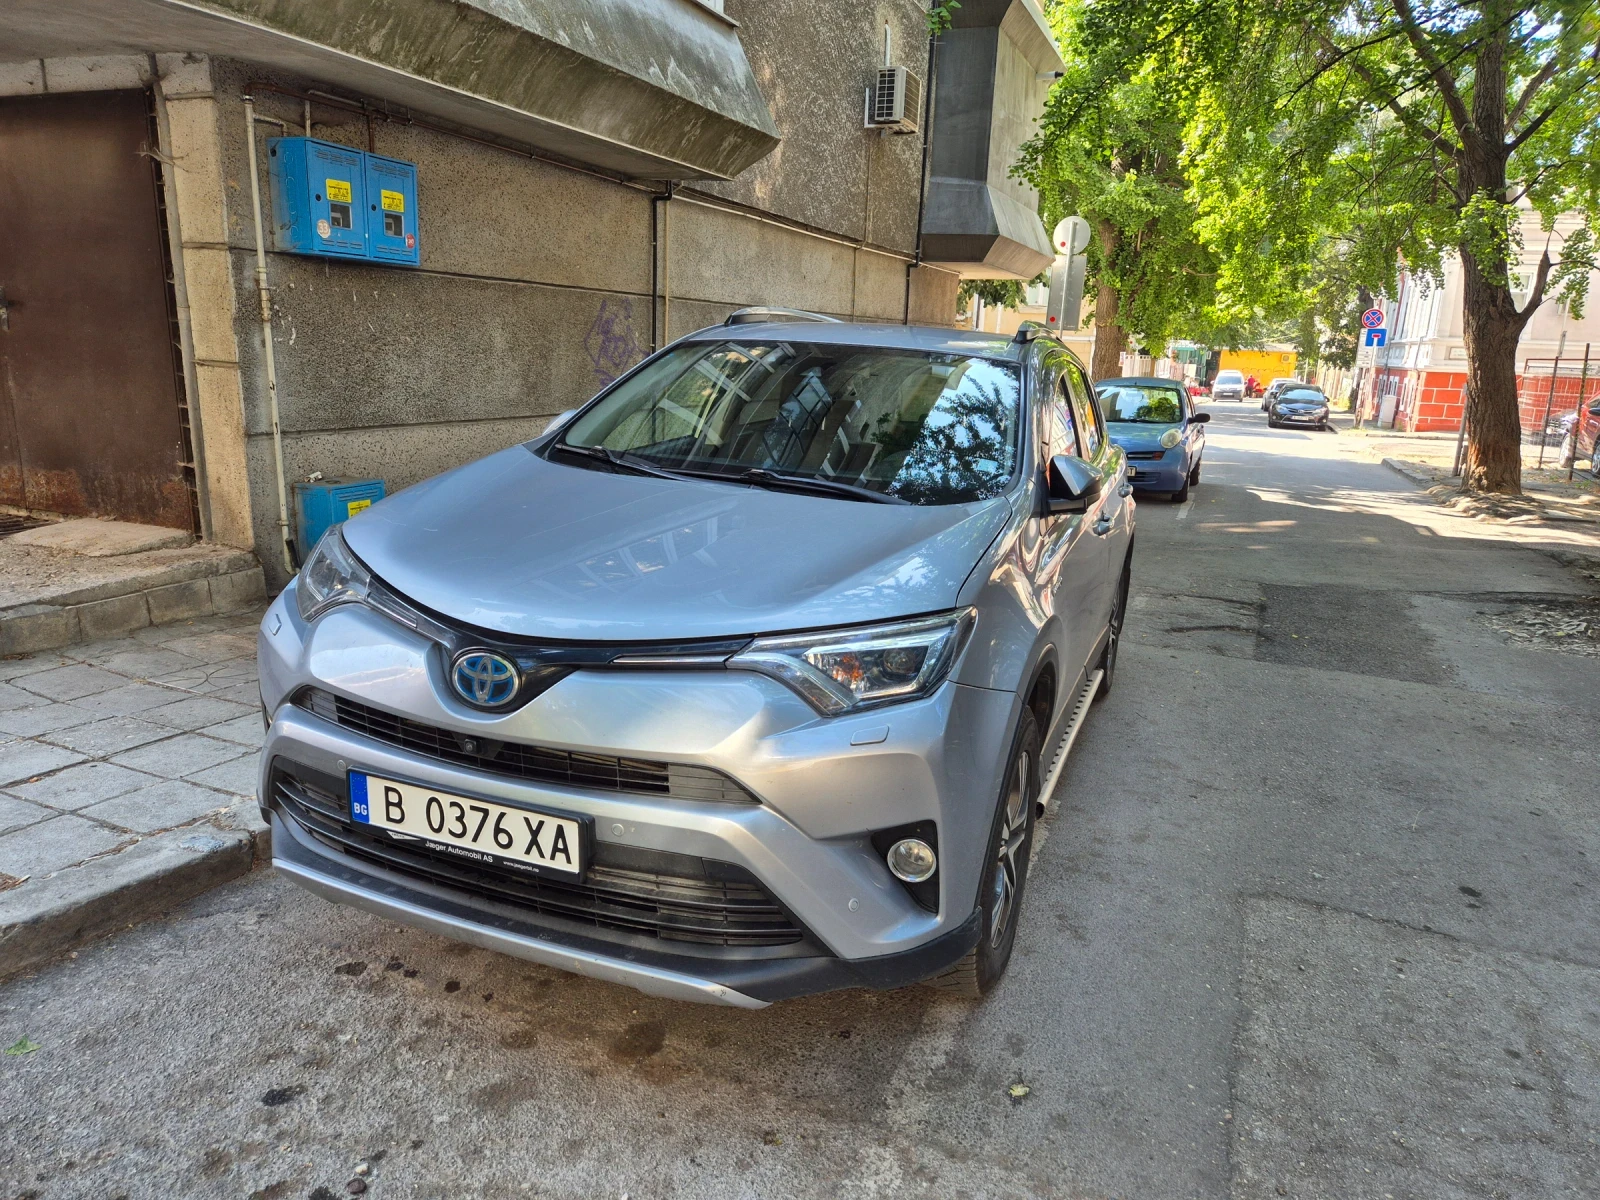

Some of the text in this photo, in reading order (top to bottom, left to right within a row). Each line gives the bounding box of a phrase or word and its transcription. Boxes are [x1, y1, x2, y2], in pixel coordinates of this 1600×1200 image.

[354, 803, 367, 815] BG
[384, 785, 572, 865] B 0376 XA
[447, 846, 482, 860] Automobil
[483, 854, 494, 864] AS
